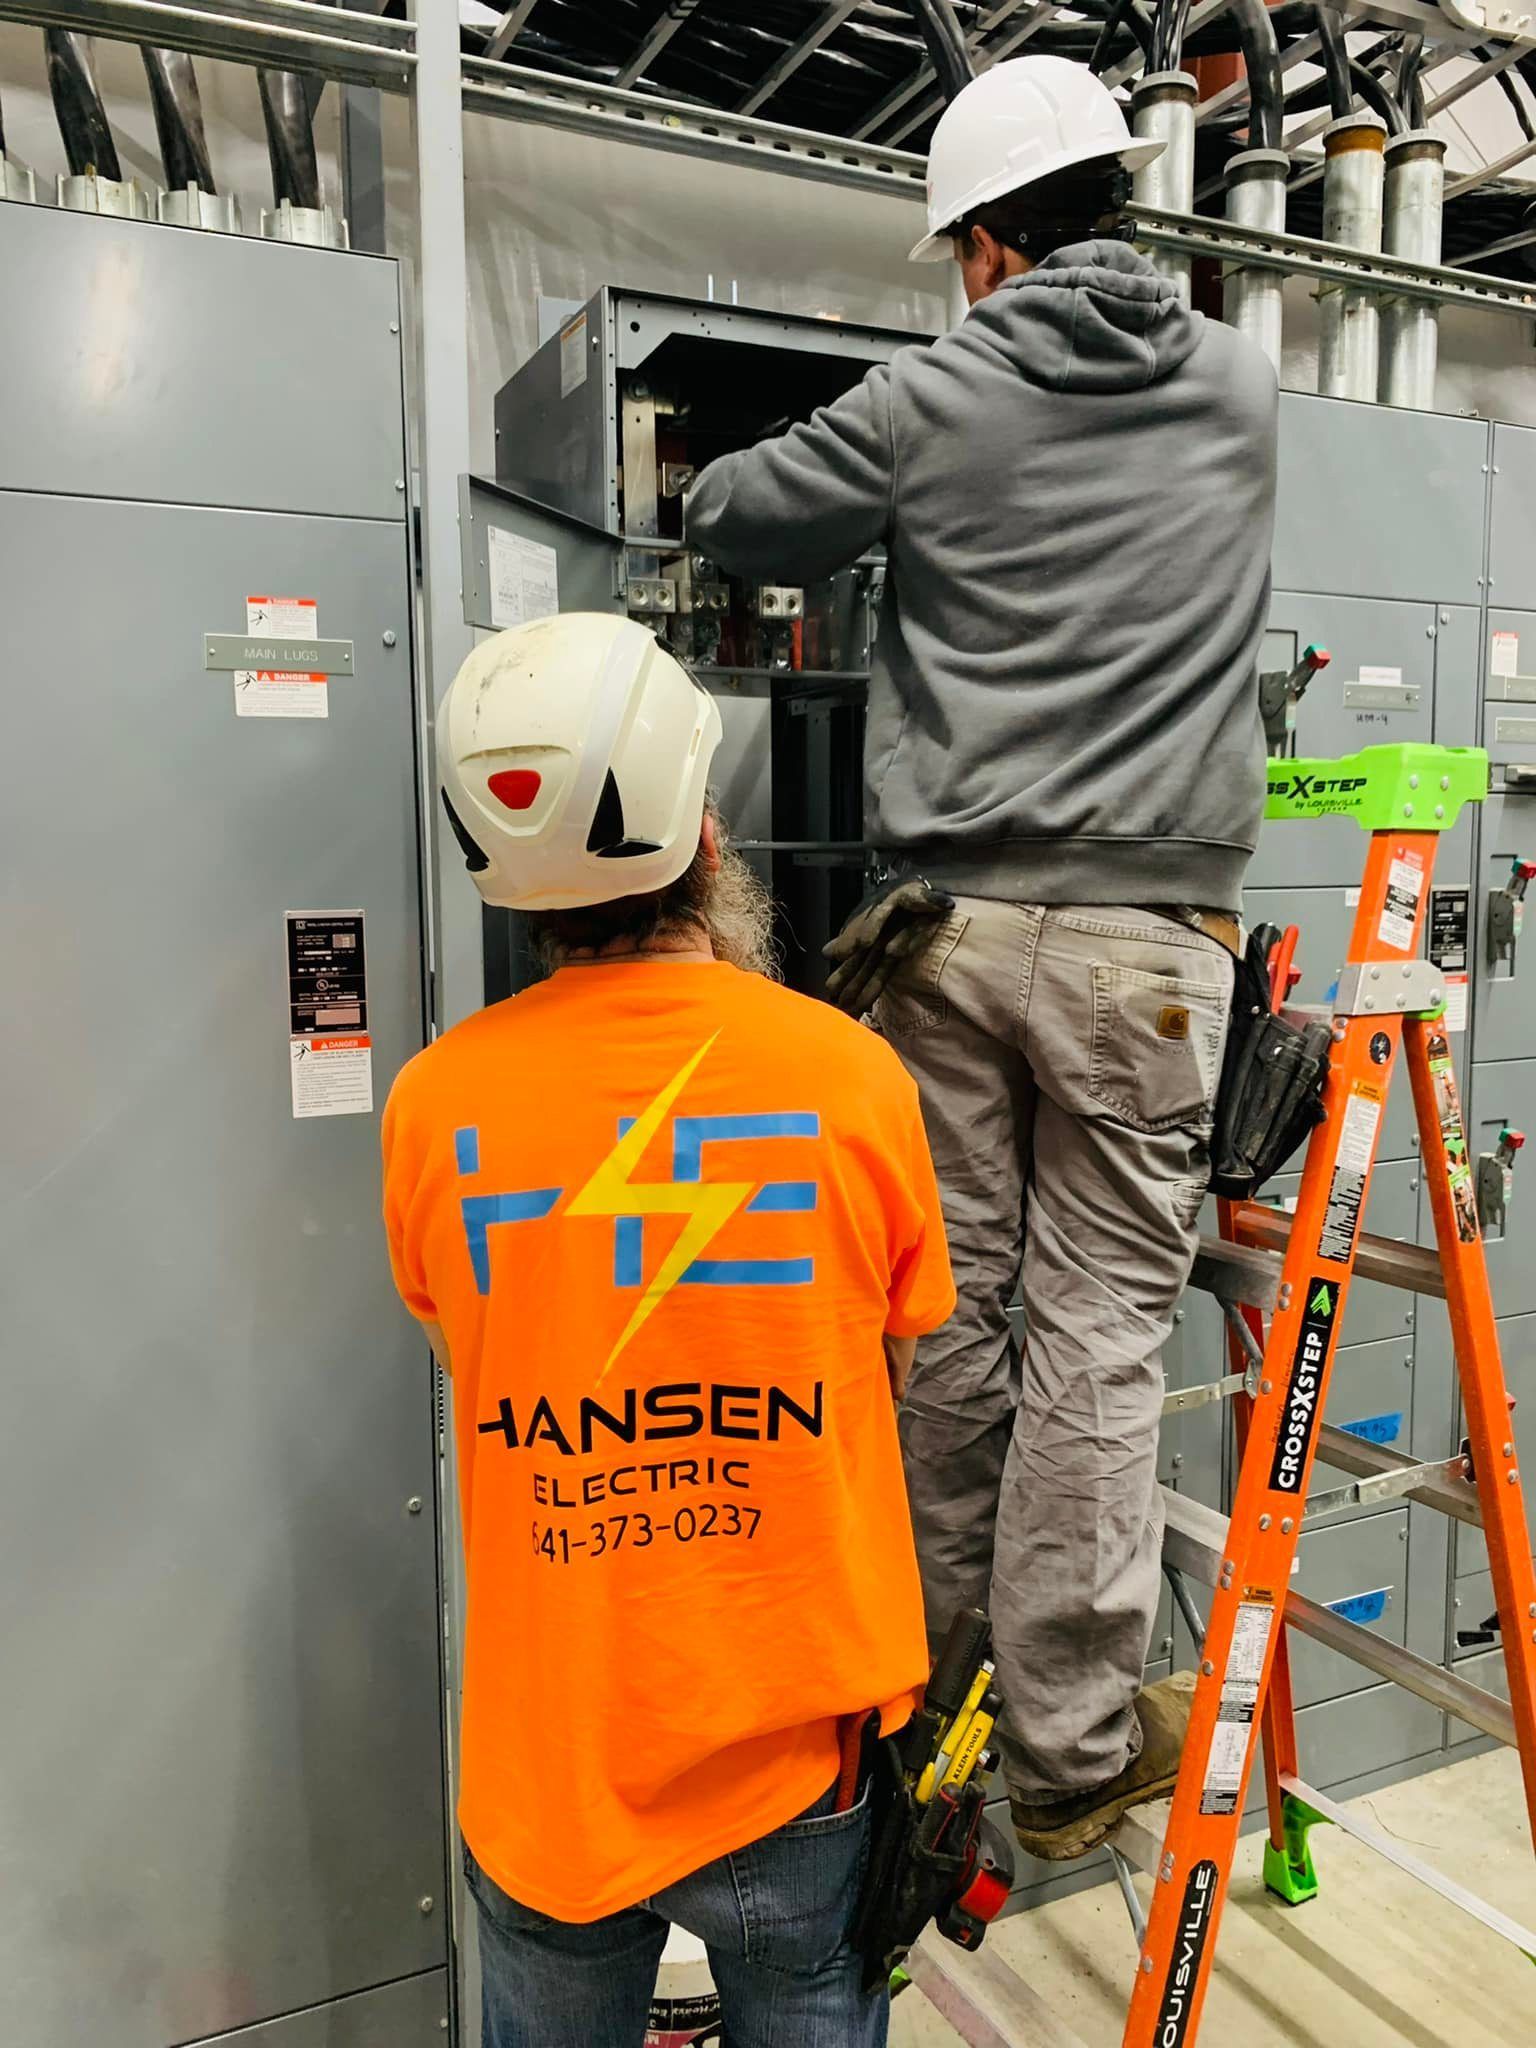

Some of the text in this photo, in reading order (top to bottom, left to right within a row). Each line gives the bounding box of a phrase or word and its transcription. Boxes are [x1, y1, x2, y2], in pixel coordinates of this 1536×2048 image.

[244, 647, 319, 662] MAIN LUGS
[274, 672, 311, 682] DANGER
[1307, 798, 1363, 808] LOUISVILLE
[329, 1040, 359, 1049] DANGER
[477, 1381, 824, 1456] HANSEN
[1278, 1332, 1324, 1489] CROSSXSTEP
[533, 1457, 750, 1508] ELECTRIC
[531, 1503, 762, 1564] 641-373-0237
[953, 1728, 982, 1779] KLEIN TOOLS
